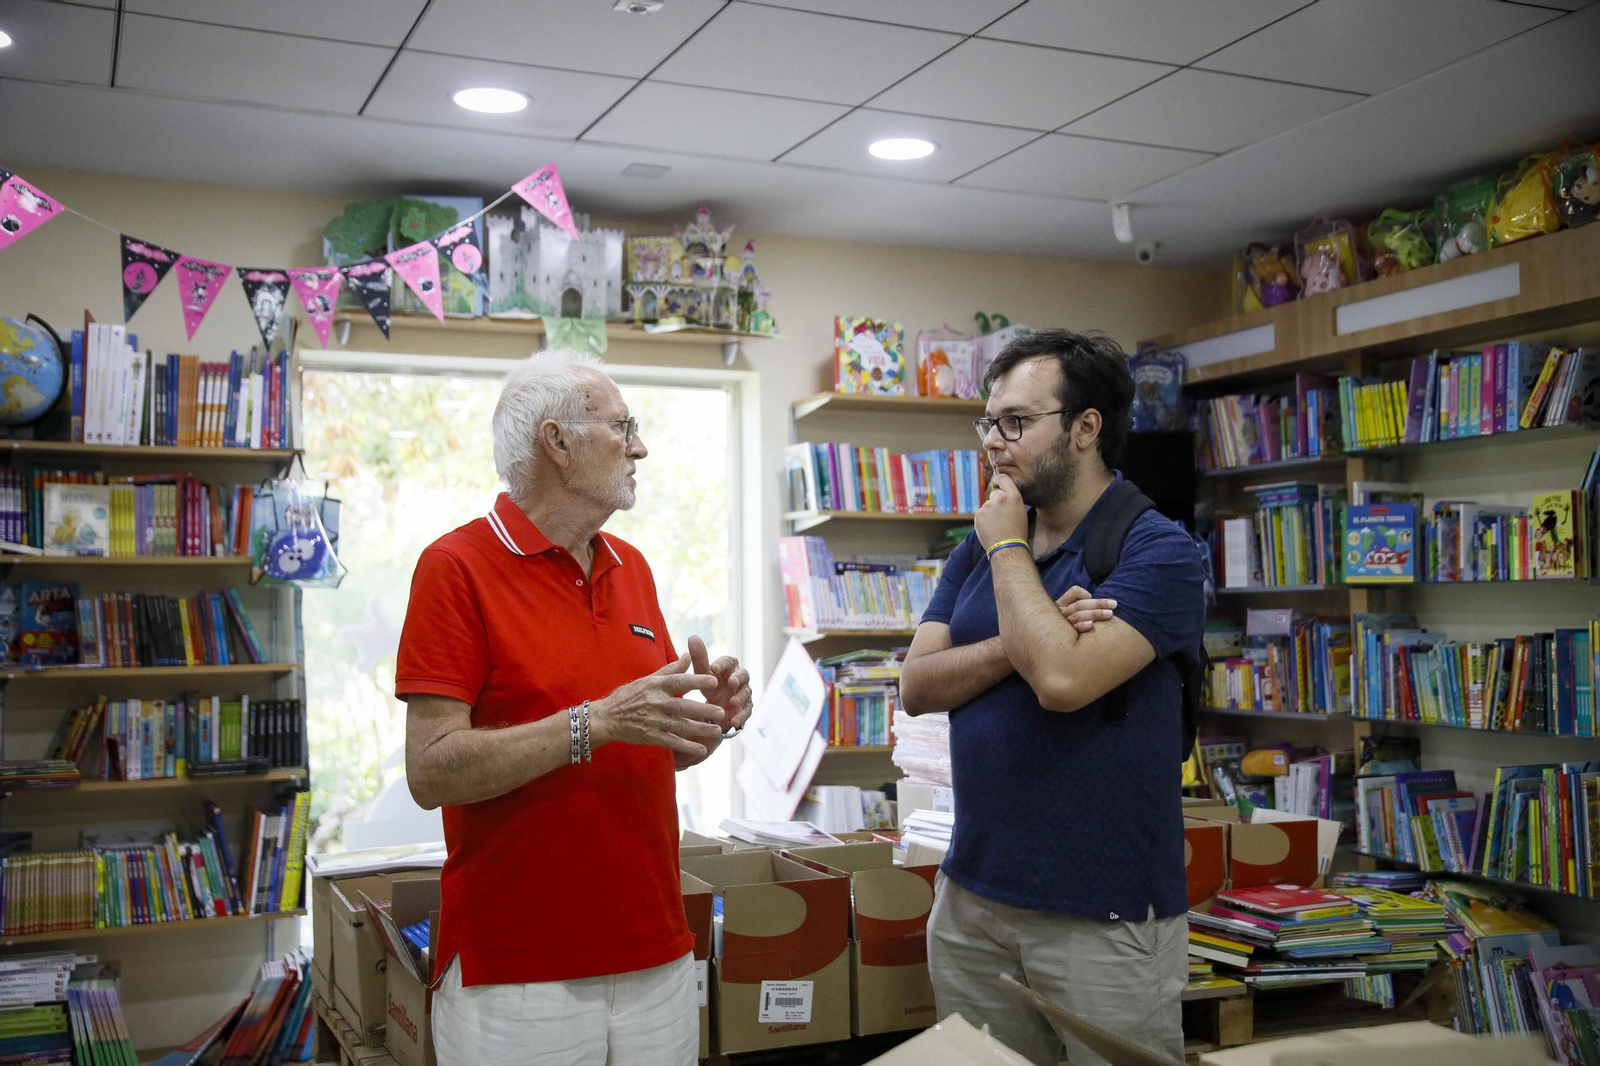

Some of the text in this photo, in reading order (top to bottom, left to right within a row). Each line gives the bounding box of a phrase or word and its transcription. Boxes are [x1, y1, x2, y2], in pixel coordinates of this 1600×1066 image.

[867, 355, 886, 366] VIDA
[1352, 514, 1406, 524] EL PLANETA TIERRA
[387, 993, 418, 1044] Santillana
[767, 1023, 807, 1034] Santillana
